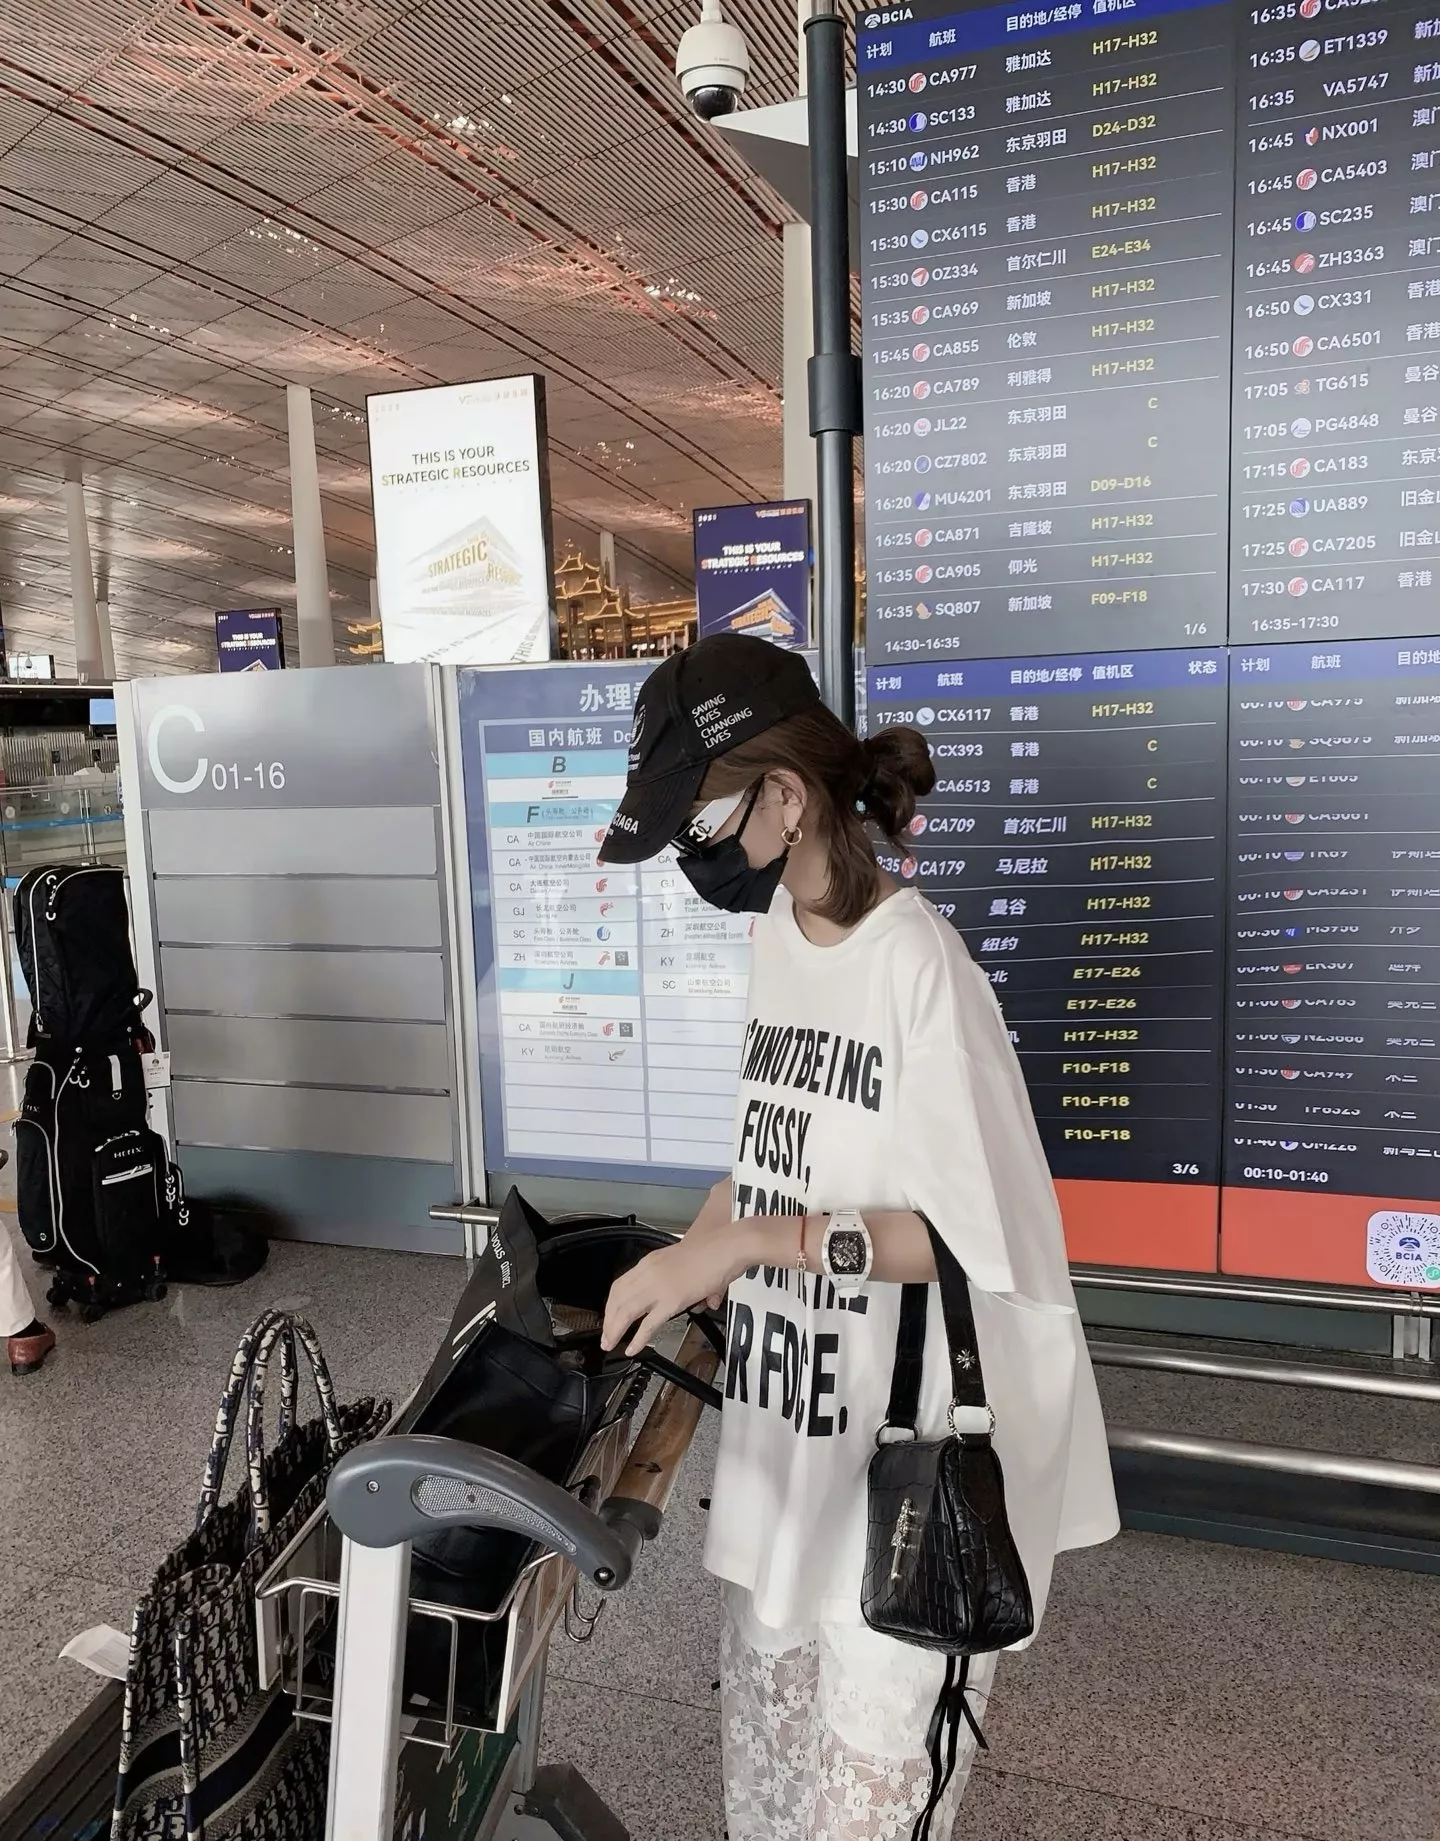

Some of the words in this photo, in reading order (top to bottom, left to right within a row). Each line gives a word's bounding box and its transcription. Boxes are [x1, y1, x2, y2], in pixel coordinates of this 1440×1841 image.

[882, 9, 913, 24] BCIA
[1251, 3, 1296, 24] 16:35
[866, 41, 892, 59] 计划
[929, 29, 956, 47] 航班
[1006, 4, 1082, 32] 目的地/经停
[1250, 47, 1295, 67] 16:35
[1324, 30, 1388, 54] ET1339
[868, 79, 906, 98] 14:30
[930, 66, 977, 86] CA977
[1006, 51, 1052, 73] 雅加达
[1093, 31, 1157, 55] H17-H32
[1249, 90, 1294, 110] 16:35
[1323, 73, 1389, 97] VA5747
[1249, 132, 1293, 152] 16:45
[1322, 118, 1378, 141] NX001
[869, 158, 907, 176] 15:10
[930, 146, 979, 165] NH962
[1006, 129, 1067, 153] 东京羽田
[1093, 115, 1156, 137] D24-D32
[1248, 217, 1292, 236] 16:45
[1319, 205, 1374, 226] SC235
[871, 273, 908, 290] 15:30
[932, 264, 978, 281] OZ334
[1007, 249, 1066, 272] 首尔仁川
[1092, 239, 1150, 259] E24-E34
[1247, 259, 1291, 278] 16:45
[1318, 246, 1384, 268] ZH3363
[872, 310, 909, 327] 15:35
[933, 302, 979, 319] CA969
[1007, 291, 1051, 311] 新加坡
[1092, 279, 1155, 298] H17-H32
[873, 347, 909, 364] 15:45
[933, 340, 979, 357] CA855
[1007, 333, 1036, 348] 伦敦
[1092, 319, 1154, 337] H17-H32
[1245, 342, 1289, 359] 16:50
[1317, 331, 1381, 351] CA6501
[1244, 383, 1288, 400] 17:05
[1316, 374, 1368, 392] TG615
[1404, 364, 1439, 383] 曼谷
[874, 422, 911, 438] 16:20
[934, 416, 967, 432] JL22
[1008, 405, 1067, 425] 东京羽田
[1148, 397, 1158, 409] C
[1244, 424, 1287, 440] 17:05
[1315, 413, 1379, 433] PG4848
[1403, 406, 1438, 424] 曼谷
[412, 453, 440, 465] THIS
[444, 450, 455, 461] IS
[458, 446, 494, 460] YOUR
[381, 468, 449, 486] STRATEGIC
[453, 460, 530, 479] RESOURCES
[1243, 463, 1286, 479] 17:15
[1314, 456, 1368, 473] CA183
[875, 496, 912, 511] 16:20
[935, 489, 992, 506] MU4201
[1008, 481, 1067, 500] 东京羽田
[1091, 475, 1151, 492] D09-D16
[876, 533, 912, 548] 16:25
[935, 527, 980, 543] CA871
[1008, 520, 1052, 538] 吉隆坡
[1092, 514, 1153, 530] H17-H32
[755, 542, 781, 553] YOUR
[428, 540, 487, 578] STRATEGIC
[1242, 581, 1284, 596] 17:30
[1311, 576, 1365, 591] CA117
[1397, 571, 1432, 588] 香港
[877, 606, 913, 620] 16:35
[935, 601, 980, 617] SQ807
[1008, 595, 1052, 612] 新加坡
[1091, 590, 1147, 606] F09-F18
[1184, 623, 1206, 635] 1/6
[1252, 615, 1339, 631] 16:35-17:30
[885, 636, 960, 652] 14:30-16:35
[1241, 658, 1270, 672] 计划
[1311, 655, 1341, 670] 航班
[876, 677, 901, 691] 计划
[937, 673, 963, 687] 航班
[1010, 667, 1082, 684] 目的地/经停
[1092, 665, 1134, 679] 值机区
[1188, 661, 1217, 675] 状态
[692, 694, 726, 718] SAVING
[877, 711, 914, 724] 17:30
[937, 708, 991, 721] CX6117
[1010, 706, 1039, 721] 香港
[1092, 702, 1154, 717] H17-H32
[695, 709, 721, 728] LIVES
[701, 707, 752, 739] CHANGING
[528, 726, 602, 747] 国内航班
[705, 730, 732, 749] LIVES
[149, 704, 208, 793] C
[212, 762, 285, 791] 01-16
[937, 744, 983, 757] CX393
[1010, 742, 1039, 757] 香港
[1147, 740, 1157, 752] C
[552, 756, 566, 773] B
[936, 780, 991, 793] CA6513
[1009, 779, 1039, 794] 香港
[1147, 778, 1157, 789] C
[526, 806, 540, 822] F
[929, 818, 975, 832] CA709
[1003, 816, 1067, 834] 首尔仁川
[1092, 814, 1152, 829] H17-H32
[506, 836, 520, 844] CA
[508, 858, 521, 867] CA
[919, 860, 966, 876] CA179
[995, 858, 1048, 874] 马尼拉
[1090, 856, 1152, 870] H17-H32
[510, 883, 522, 892] CA
[660, 879, 674, 888] GJ
[513, 907, 525, 915] GJ
[660, 902, 672, 911] TV
[989, 899, 1027, 917] 曼谷
[1087, 896, 1150, 910] H17-H32
[513, 930, 525, 938] SC
[660, 929, 674, 937] ZH
[980, 936, 1019, 952] 纽约
[1081, 933, 1148, 946] H17-H32
[513, 952, 525, 961] ZH
[660, 957, 675, 966] KY
[563, 974, 575, 990] J
[1073, 968, 1141, 979] E17-E26
[662, 980, 676, 989] SC
[1067, 999, 1136, 1010] E17-E26
[518, 1023, 531, 1032] CA
[1064, 1030, 1138, 1042] H17-H32
[1062, 1062, 1130, 1074] F10-F18
[1062, 1096, 1130, 1107] F10-F18
[1065, 1129, 1130, 1140] F10-F18
[739, 1099, 812, 1194] FUSSY,
[1172, 1163, 1199, 1174] 3/6
[1244, 1167, 1329, 1183] 00:10-01:40
[1396, 1252, 1422, 1262] BCIA
